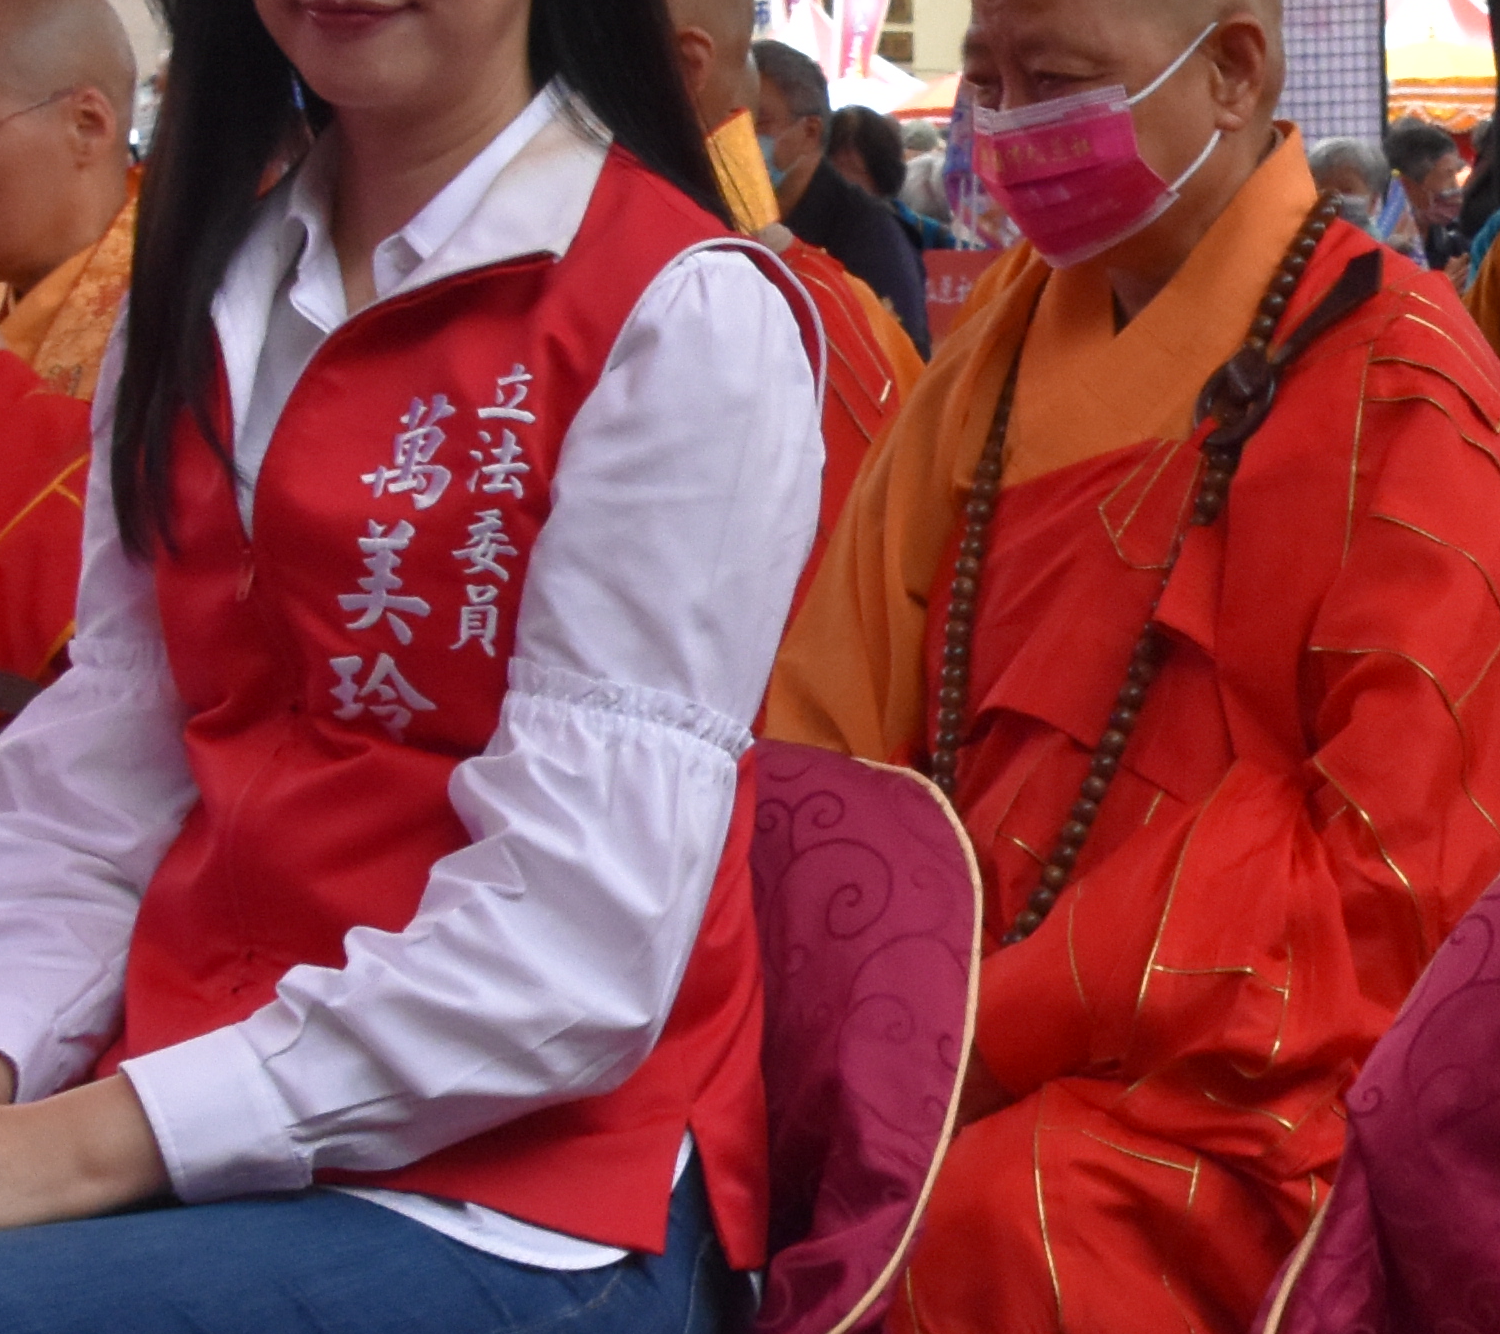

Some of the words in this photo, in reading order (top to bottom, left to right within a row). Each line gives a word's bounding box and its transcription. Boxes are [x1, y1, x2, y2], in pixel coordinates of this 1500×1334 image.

[328, 393, 457, 731] 萬美玲
[450, 363, 537, 659] 立法委員
